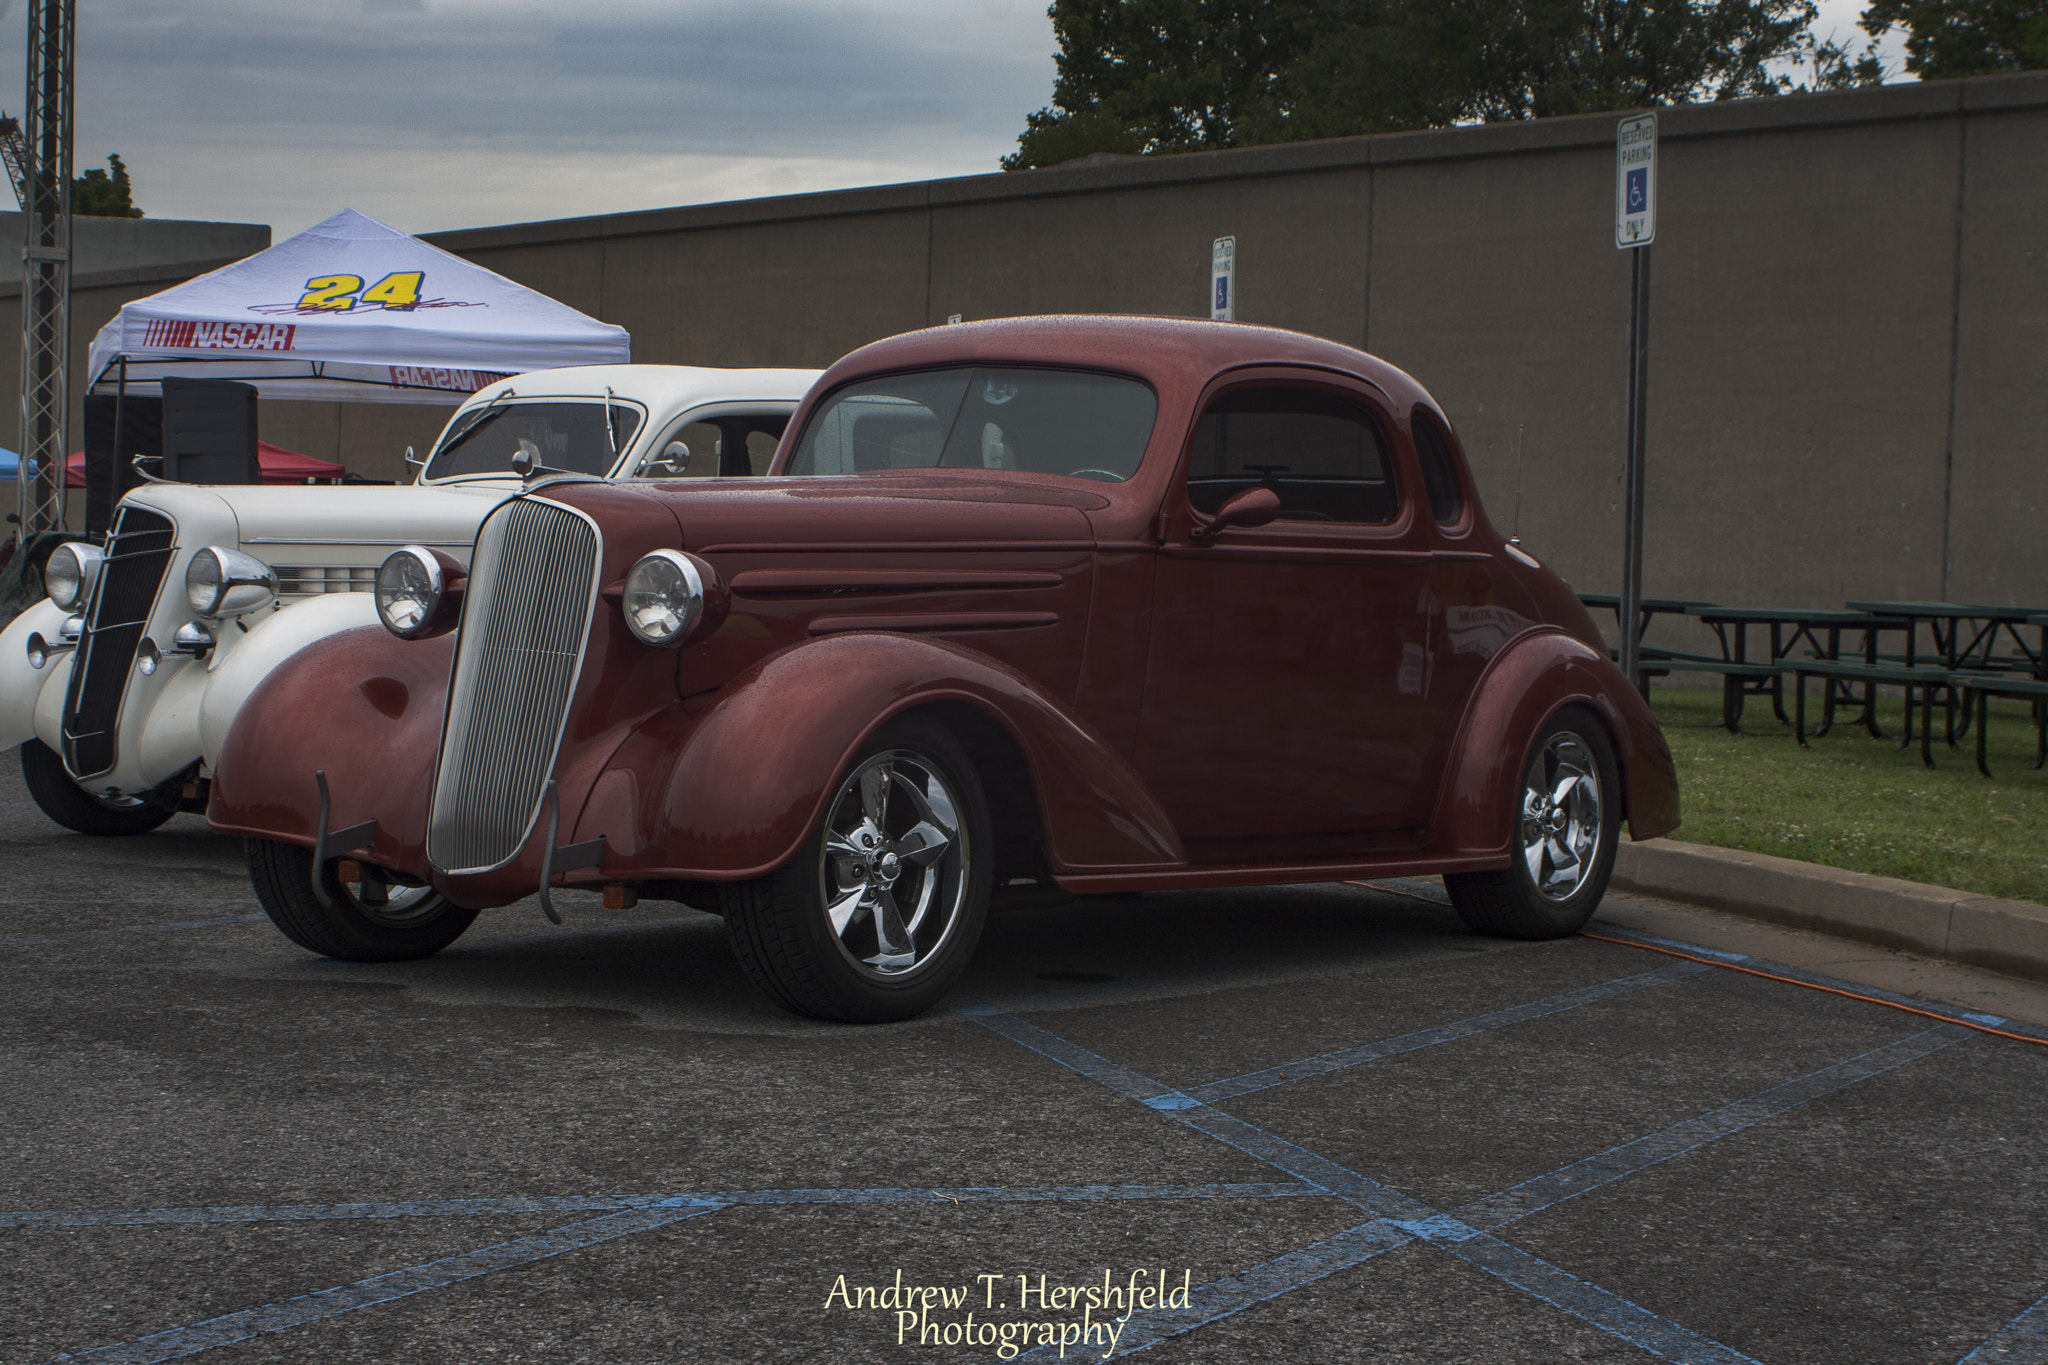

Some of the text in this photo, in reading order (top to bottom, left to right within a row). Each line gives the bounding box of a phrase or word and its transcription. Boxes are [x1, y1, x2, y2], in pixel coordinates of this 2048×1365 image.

[1621, 125, 1653, 146] RESERVED
[1621, 145, 1652, 165] PARKING
[1626, 219, 1645, 236] ONLY
[295, 270, 426, 312] 24
[190, 321, 289, 350] NASCAR
